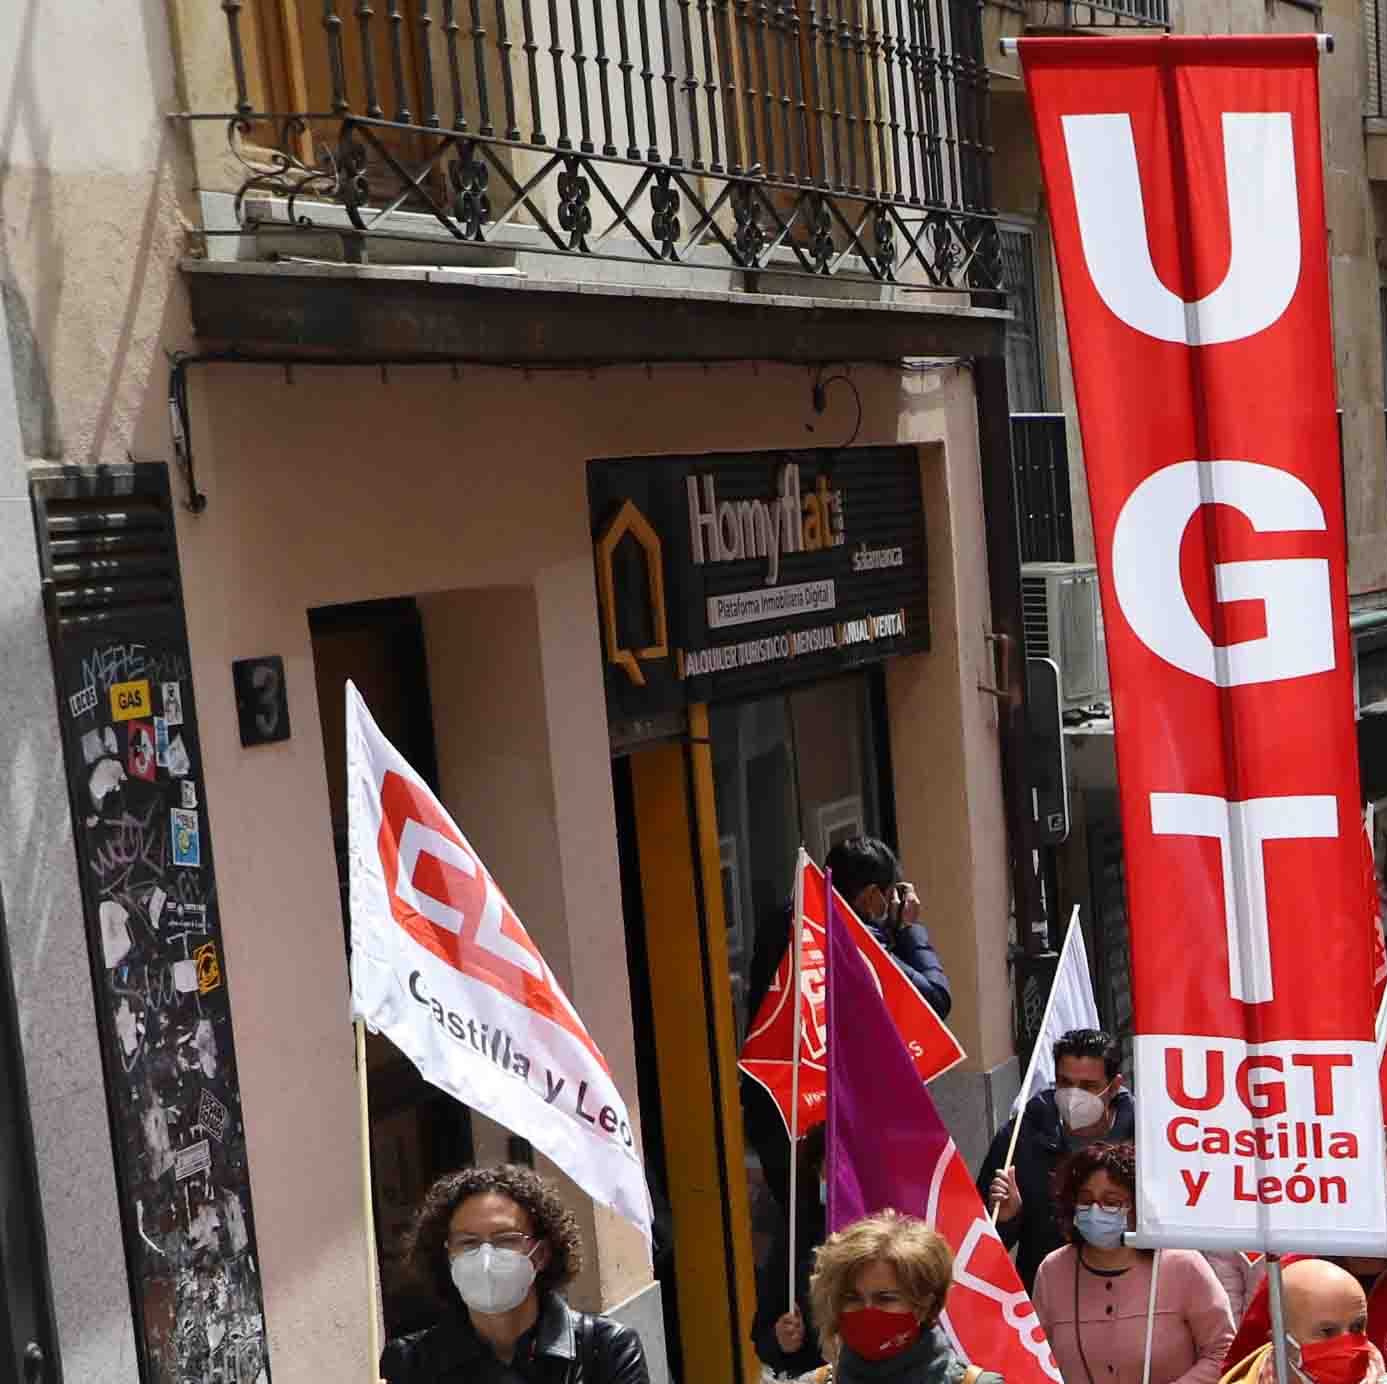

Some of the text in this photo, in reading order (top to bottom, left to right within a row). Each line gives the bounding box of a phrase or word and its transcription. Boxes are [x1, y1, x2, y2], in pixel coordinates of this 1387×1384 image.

[686, 463, 833, 586] Homyflat
[1061, 111, 1339, 1003] UGT
[805, 583, 829, 607] Digital
[685, 646, 737, 677] ALQUILER
[792, 626, 836, 656] MENSUAL
[840, 619, 870, 646] ANUAL
[873, 612, 902, 639] VENTA
[118, 690, 143, 710] GAS
[252, 665, 280, 737] 3
[408, 969, 532, 1084] Castilla
[544, 1067, 567, 1104] y
[1164, 1047, 1353, 1119] UGT
[1166, 1116, 1359, 1160] Castilla
[1180, 1162, 1348, 1207] y León
